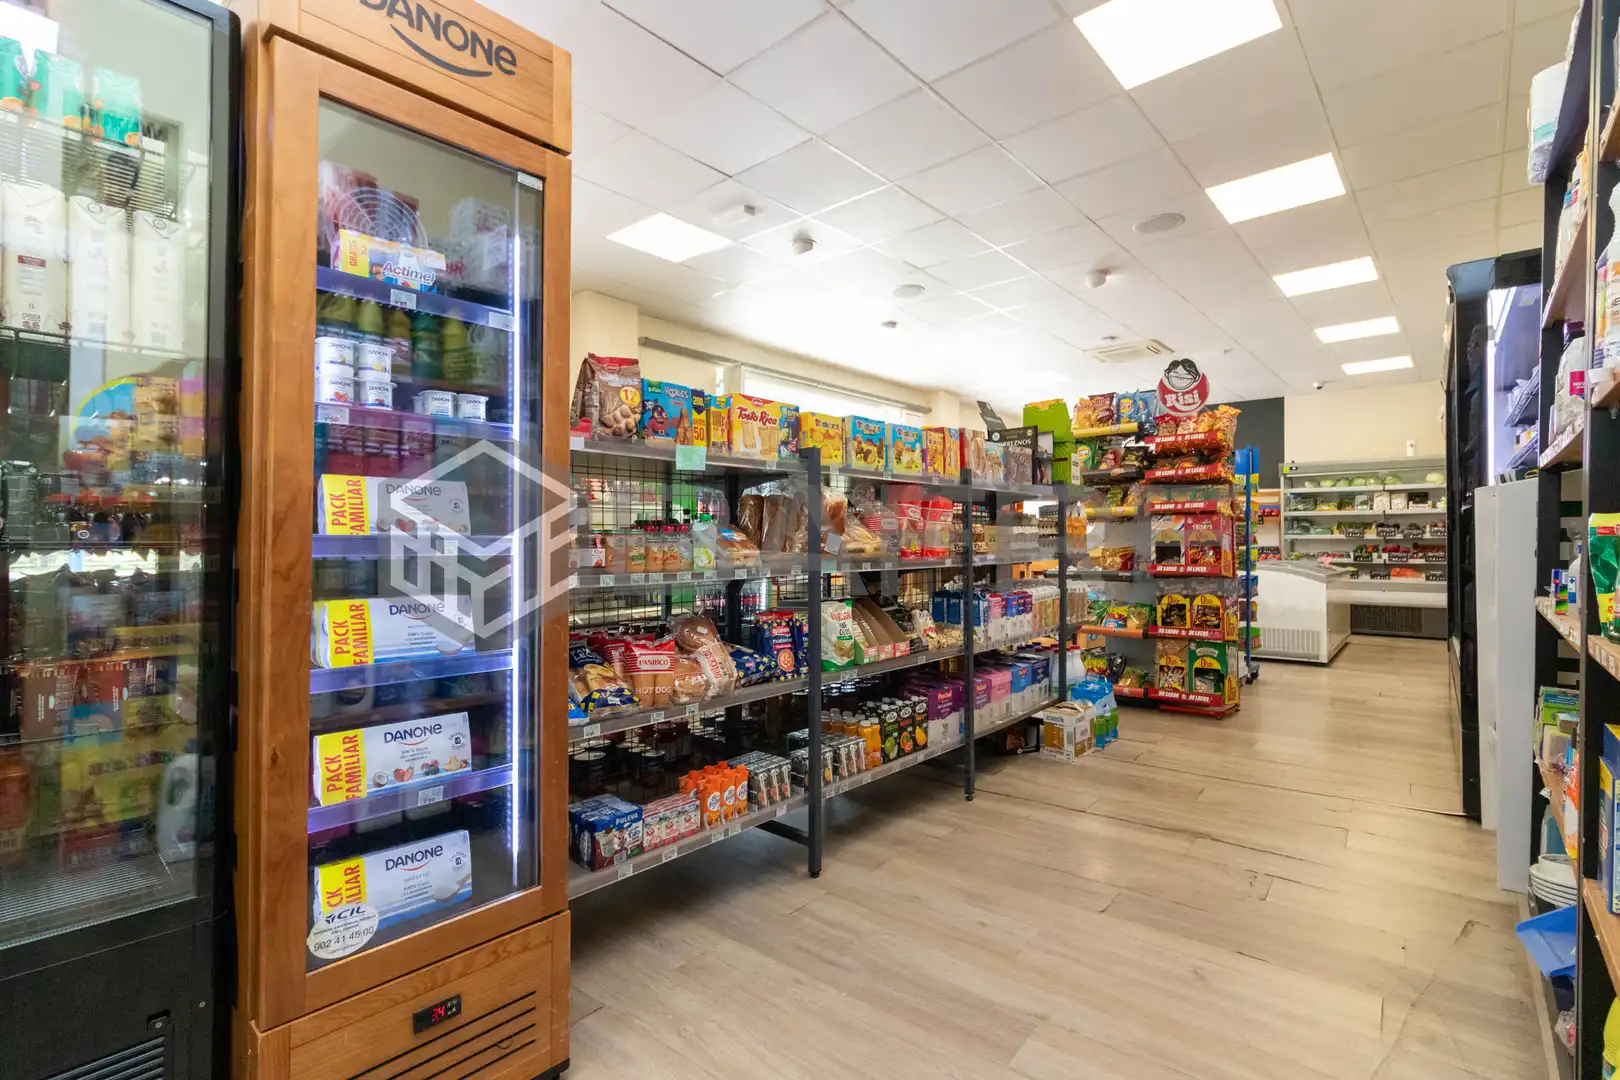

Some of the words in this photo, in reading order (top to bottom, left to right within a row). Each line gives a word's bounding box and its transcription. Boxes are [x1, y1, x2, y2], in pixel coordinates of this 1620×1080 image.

[382, 262, 435, 282] Actimel
[1165, 389, 1199, 406] Risi
[331, 492, 348, 527] PACK
[346, 479, 367, 535] AMILIAR
[334, 619, 351, 655] PACK
[635, 687, 653, 695] HOT
[654, 686, 672, 694] DOG
[322, 754, 342, 793] PACK
[313, 939, 332, 952] 902
[334, 935, 346, 944] 41
[348, 931, 361, 941] 45
[362, 926, 375, 936] 00
